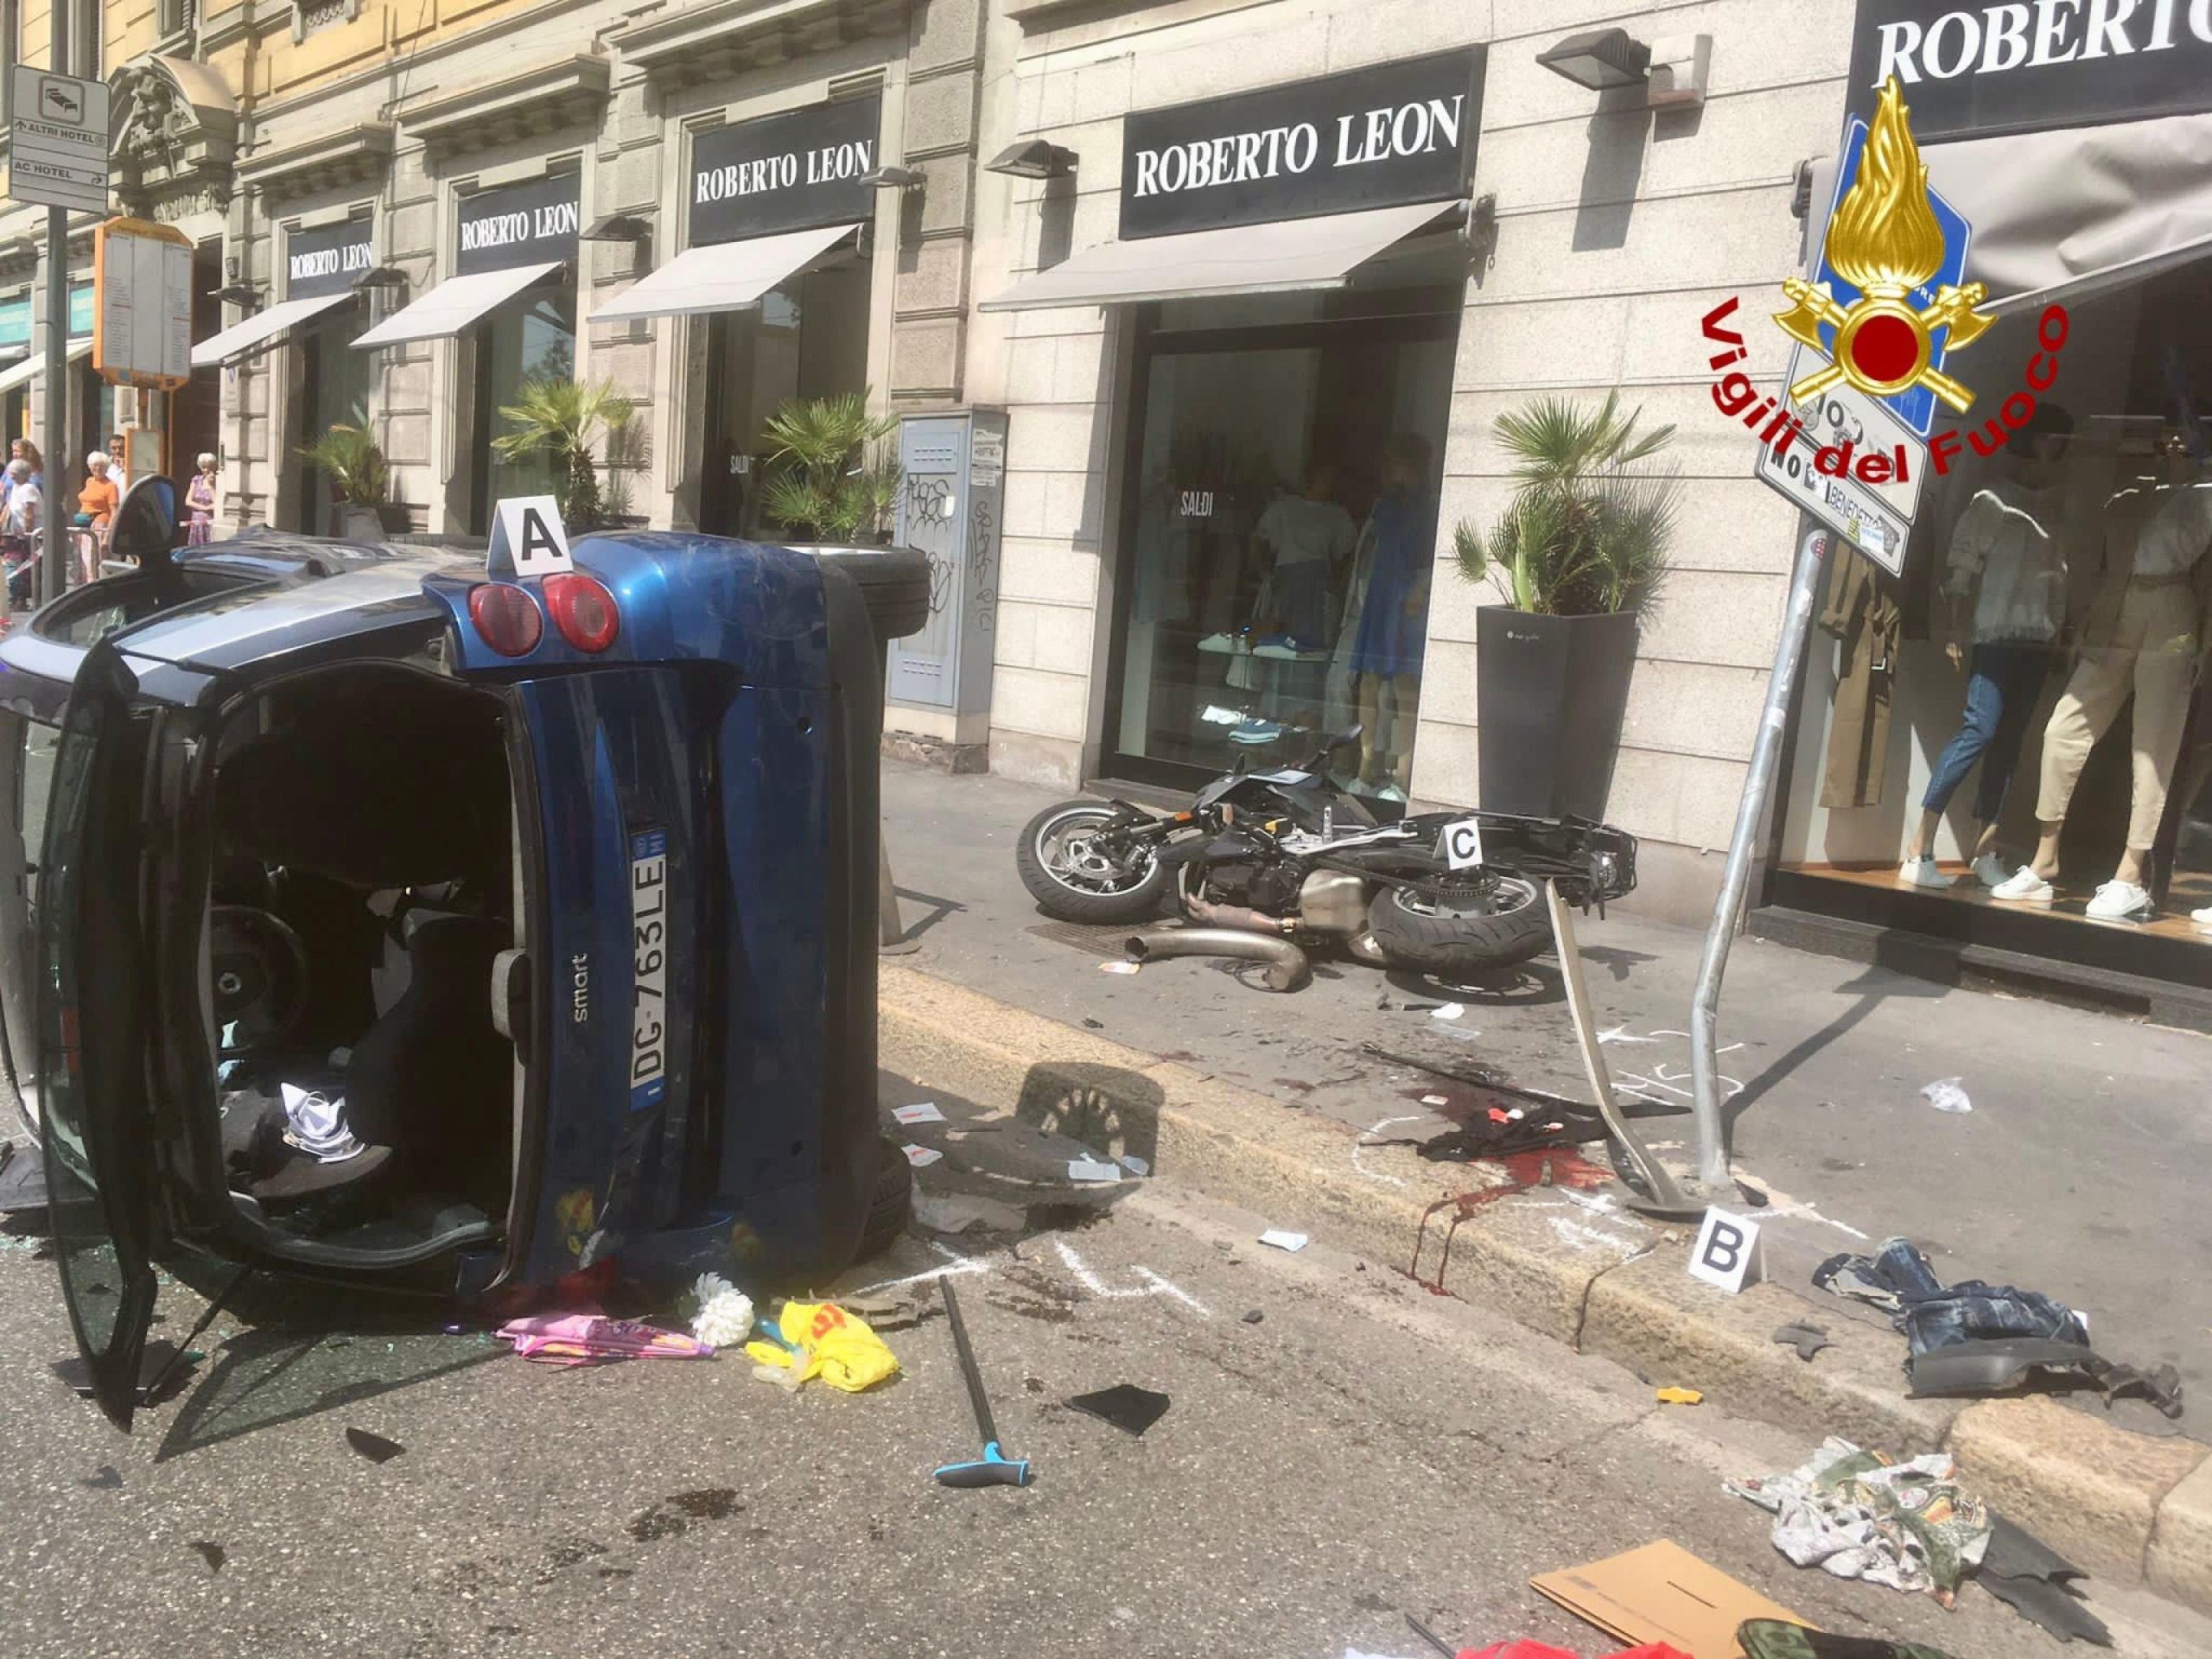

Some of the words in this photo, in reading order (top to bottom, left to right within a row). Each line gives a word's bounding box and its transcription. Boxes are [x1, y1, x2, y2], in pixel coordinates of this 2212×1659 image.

[28, 124, 59, 137] ALTRI
[60, 130, 95, 143] HOTEL
[1134, 122, 1319, 197] ROBERTO
[1332, 95, 1466, 168] LEON
[15, 162, 31, 171] AC
[34, 165, 72, 179] HOTEL
[696, 153, 798, 203] ROBERTO
[805, 139, 873, 185] LEON
[461, 211, 529, 251] ROBERTO
[534, 200, 579, 238] LEON
[290, 249, 339, 280] ROBERTO
[1180, 491, 1214, 517] SALDI
[521, 507, 563, 562] A
[1452, 828, 1476, 859] C
[571, 953, 588, 1023] smart
[1701, 1219, 1744, 1273] B
